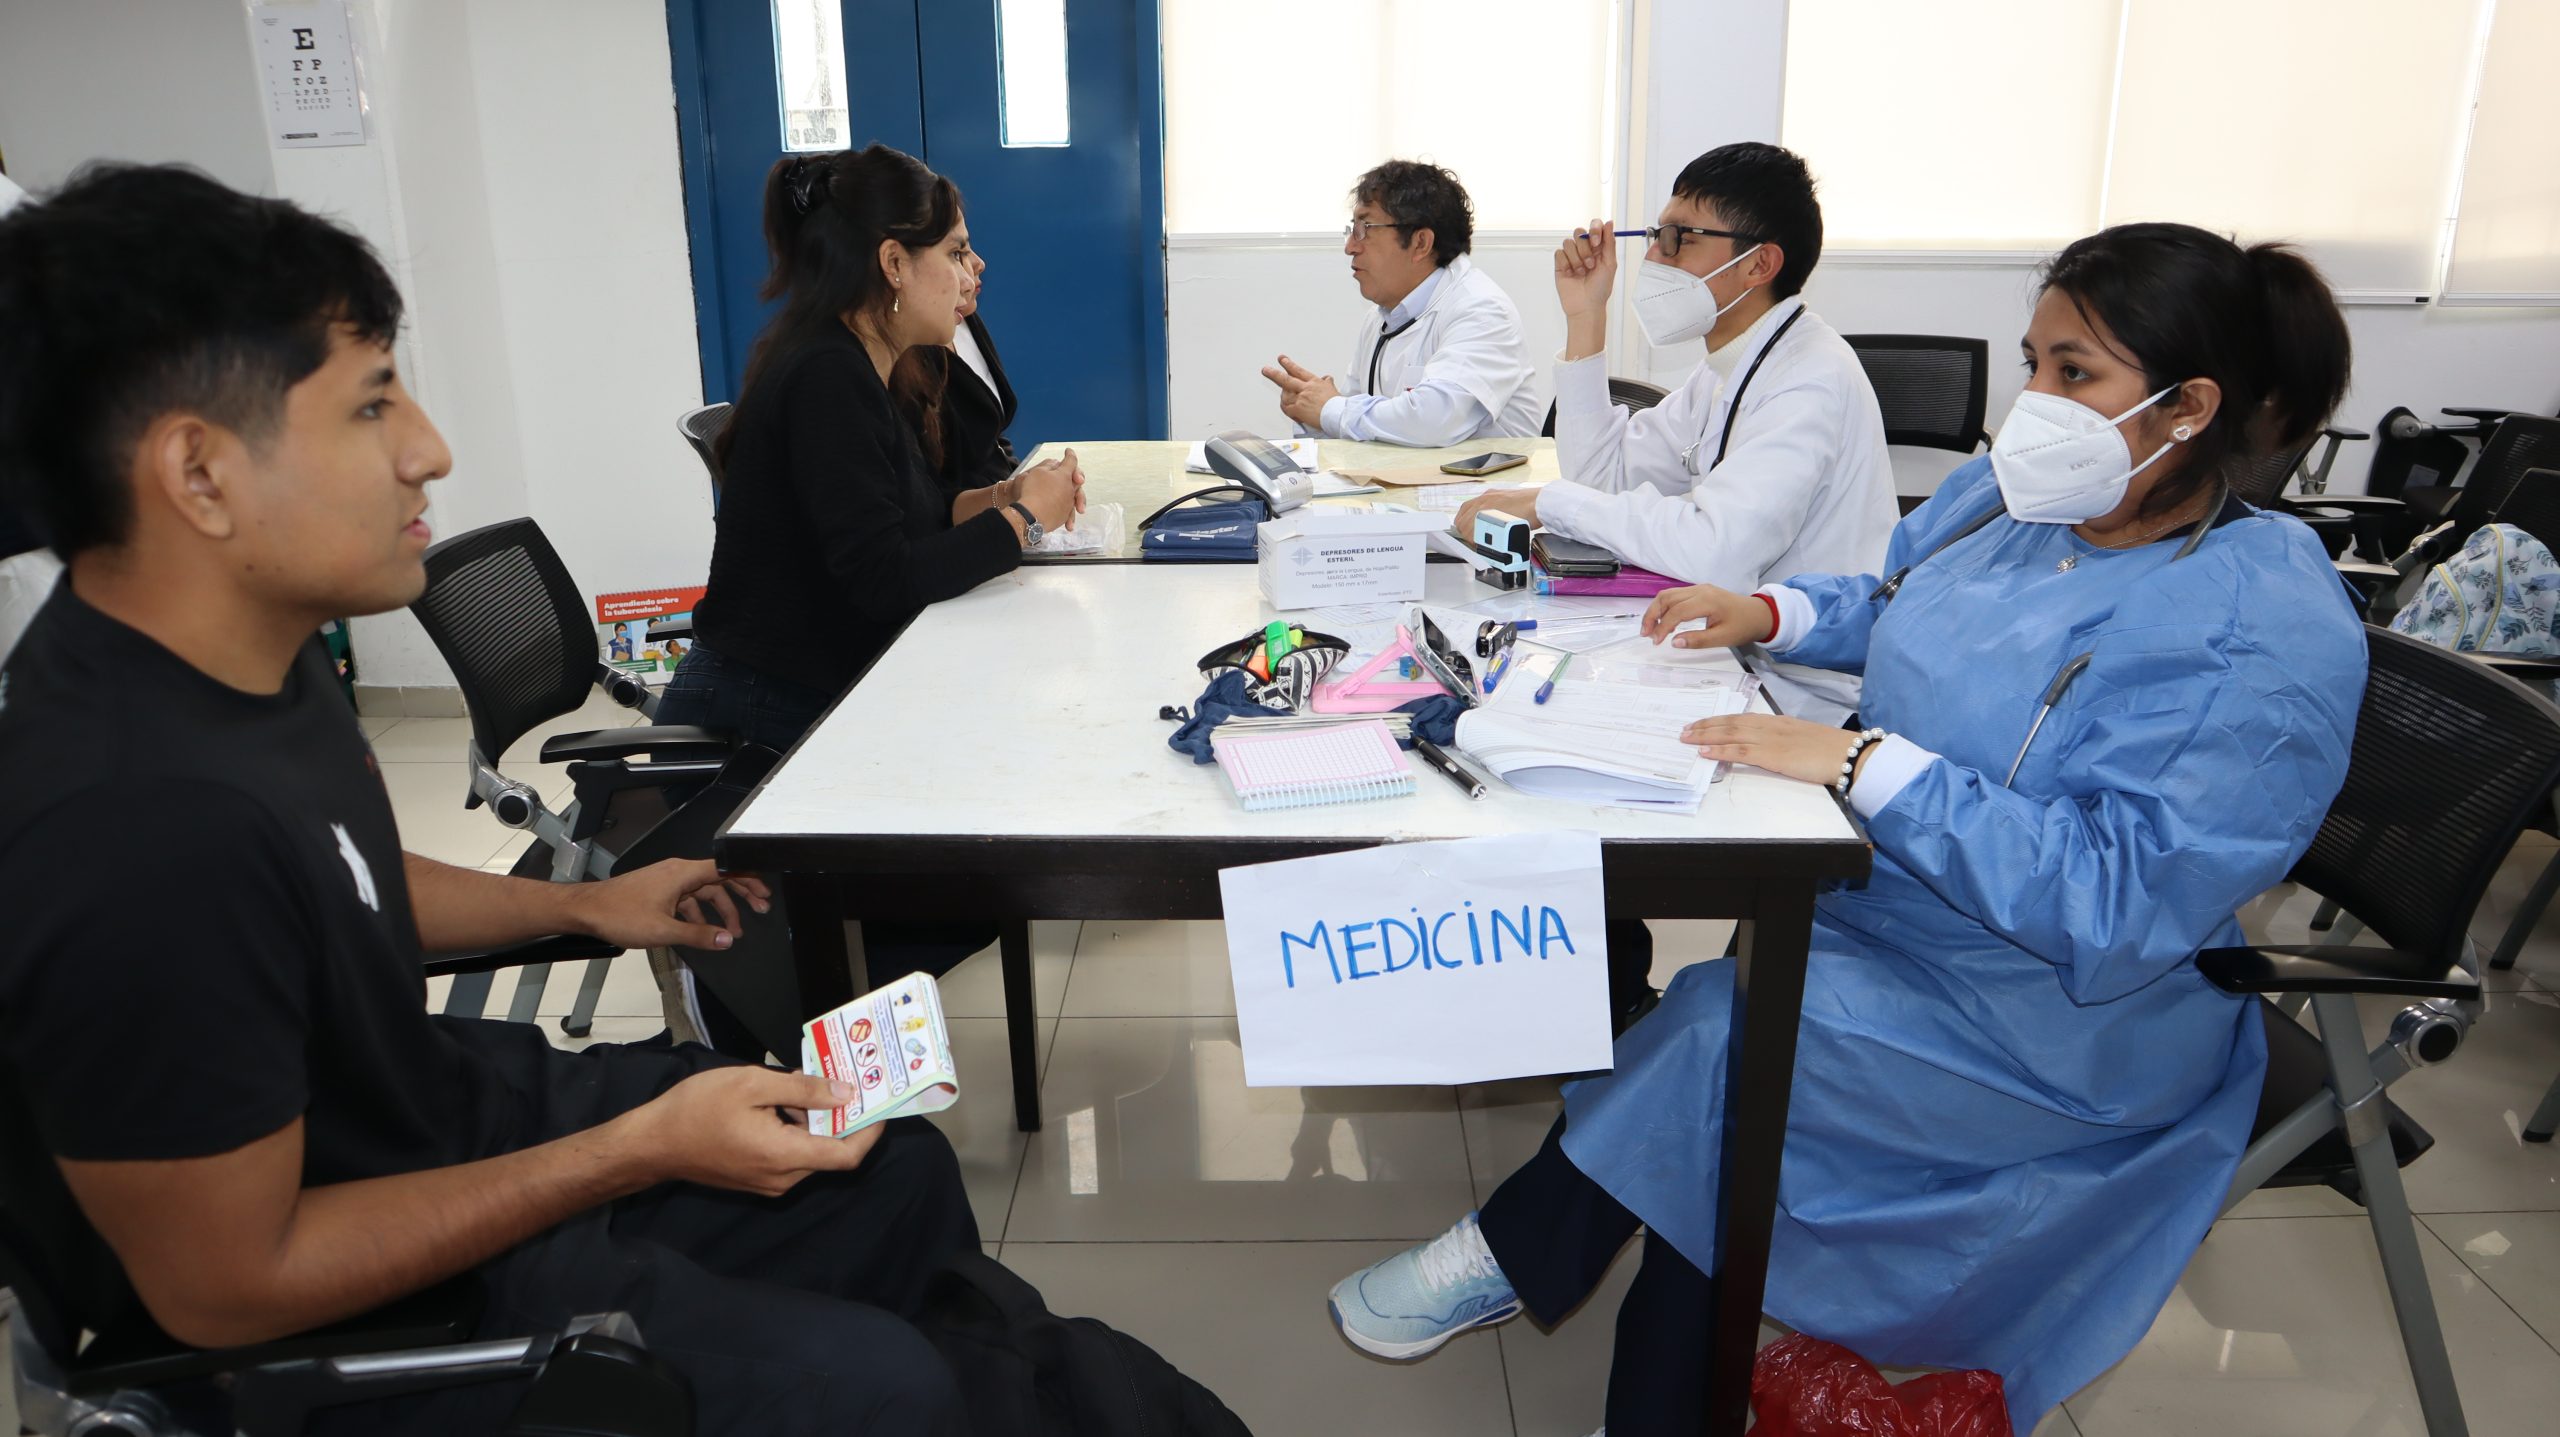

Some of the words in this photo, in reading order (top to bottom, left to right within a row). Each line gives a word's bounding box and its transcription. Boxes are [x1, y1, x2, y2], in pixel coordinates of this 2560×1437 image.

[292, 28, 315, 50] E
[2069, 458, 2097, 471] KN95
[1320, 548, 1365, 557] DEPRESORES
[1377, 545, 1404, 553] LENGUA
[1327, 556, 1355, 564] ESTERIL
[604, 598, 656, 610] Aprendiendo
[656, 597, 679, 605] sobre
[604, 609, 613, 617] la
[613, 605, 663, 616] tuberculosis
